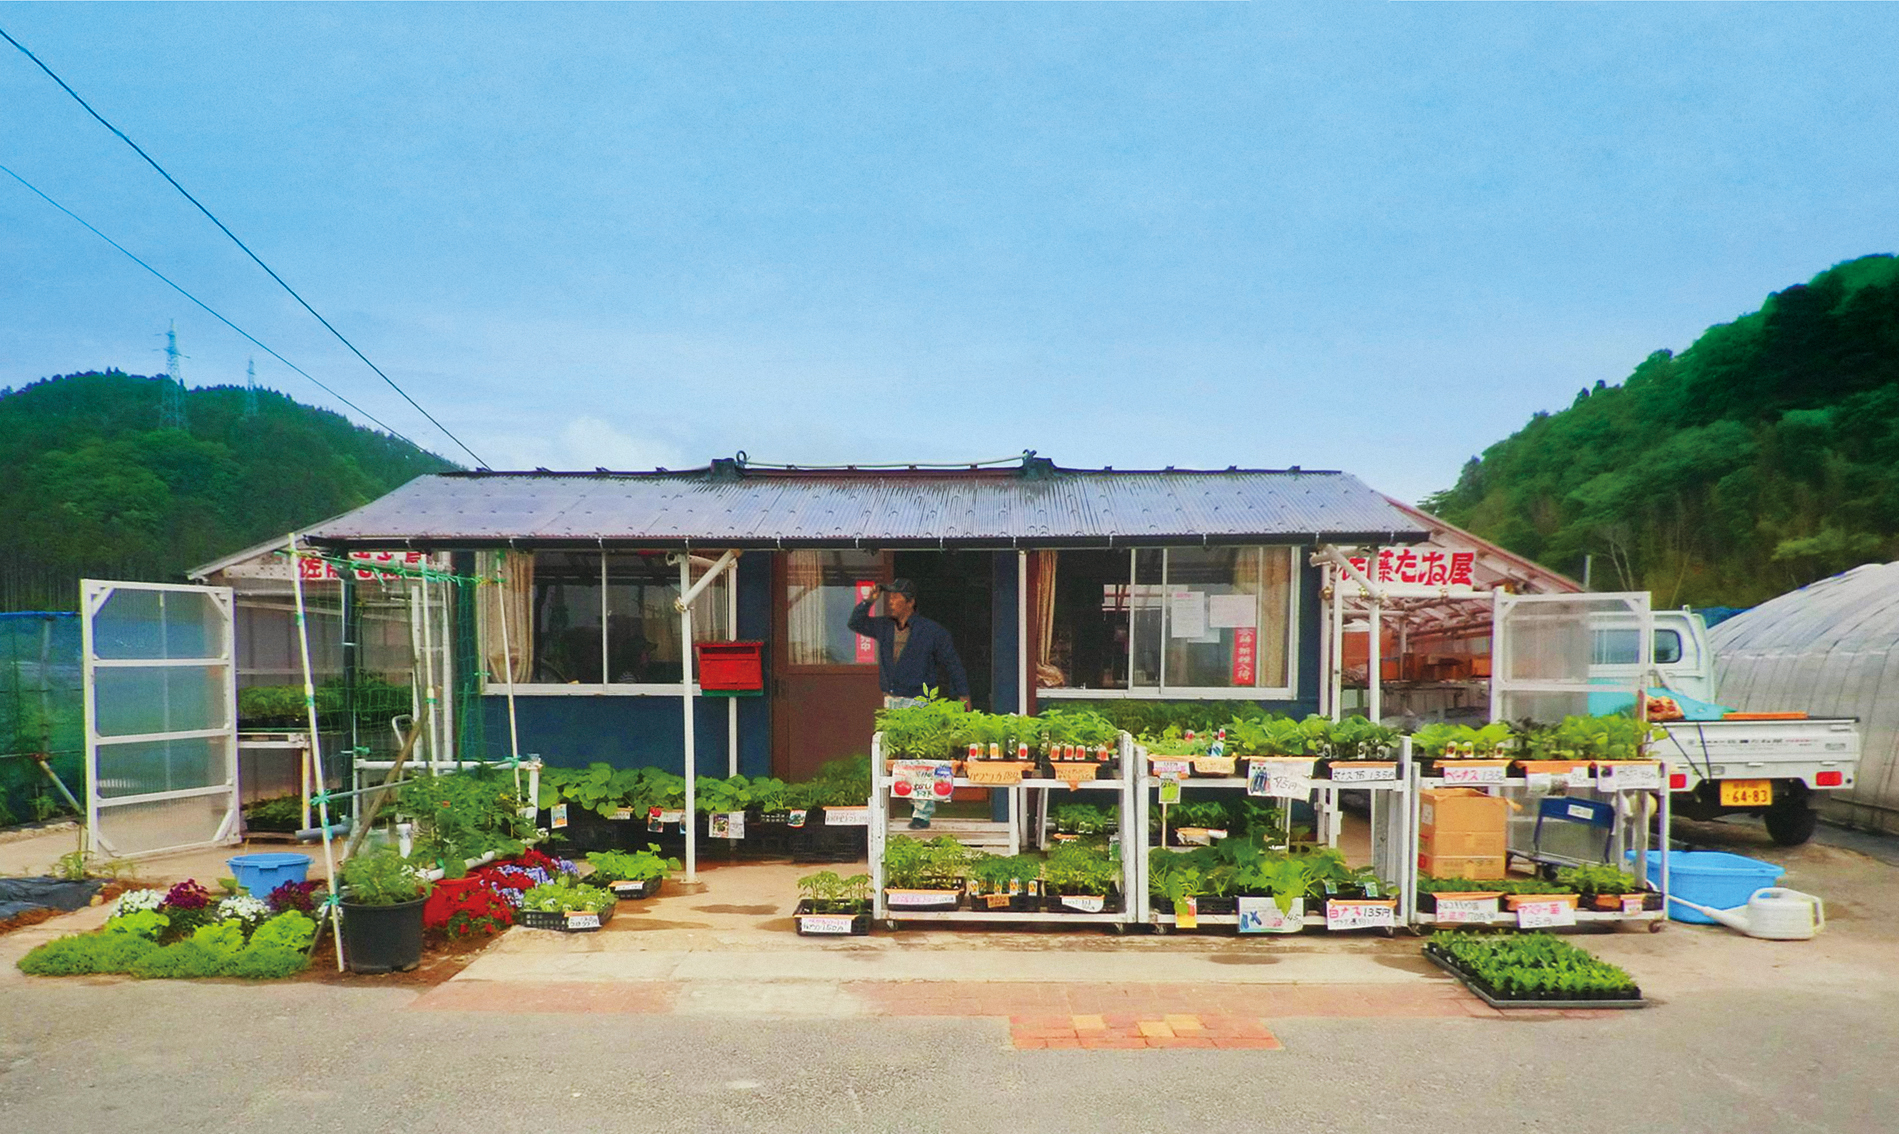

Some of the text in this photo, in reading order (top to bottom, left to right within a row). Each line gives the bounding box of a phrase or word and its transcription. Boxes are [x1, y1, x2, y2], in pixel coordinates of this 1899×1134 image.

[1329, 905, 1391, 919] 白ナス 135円
